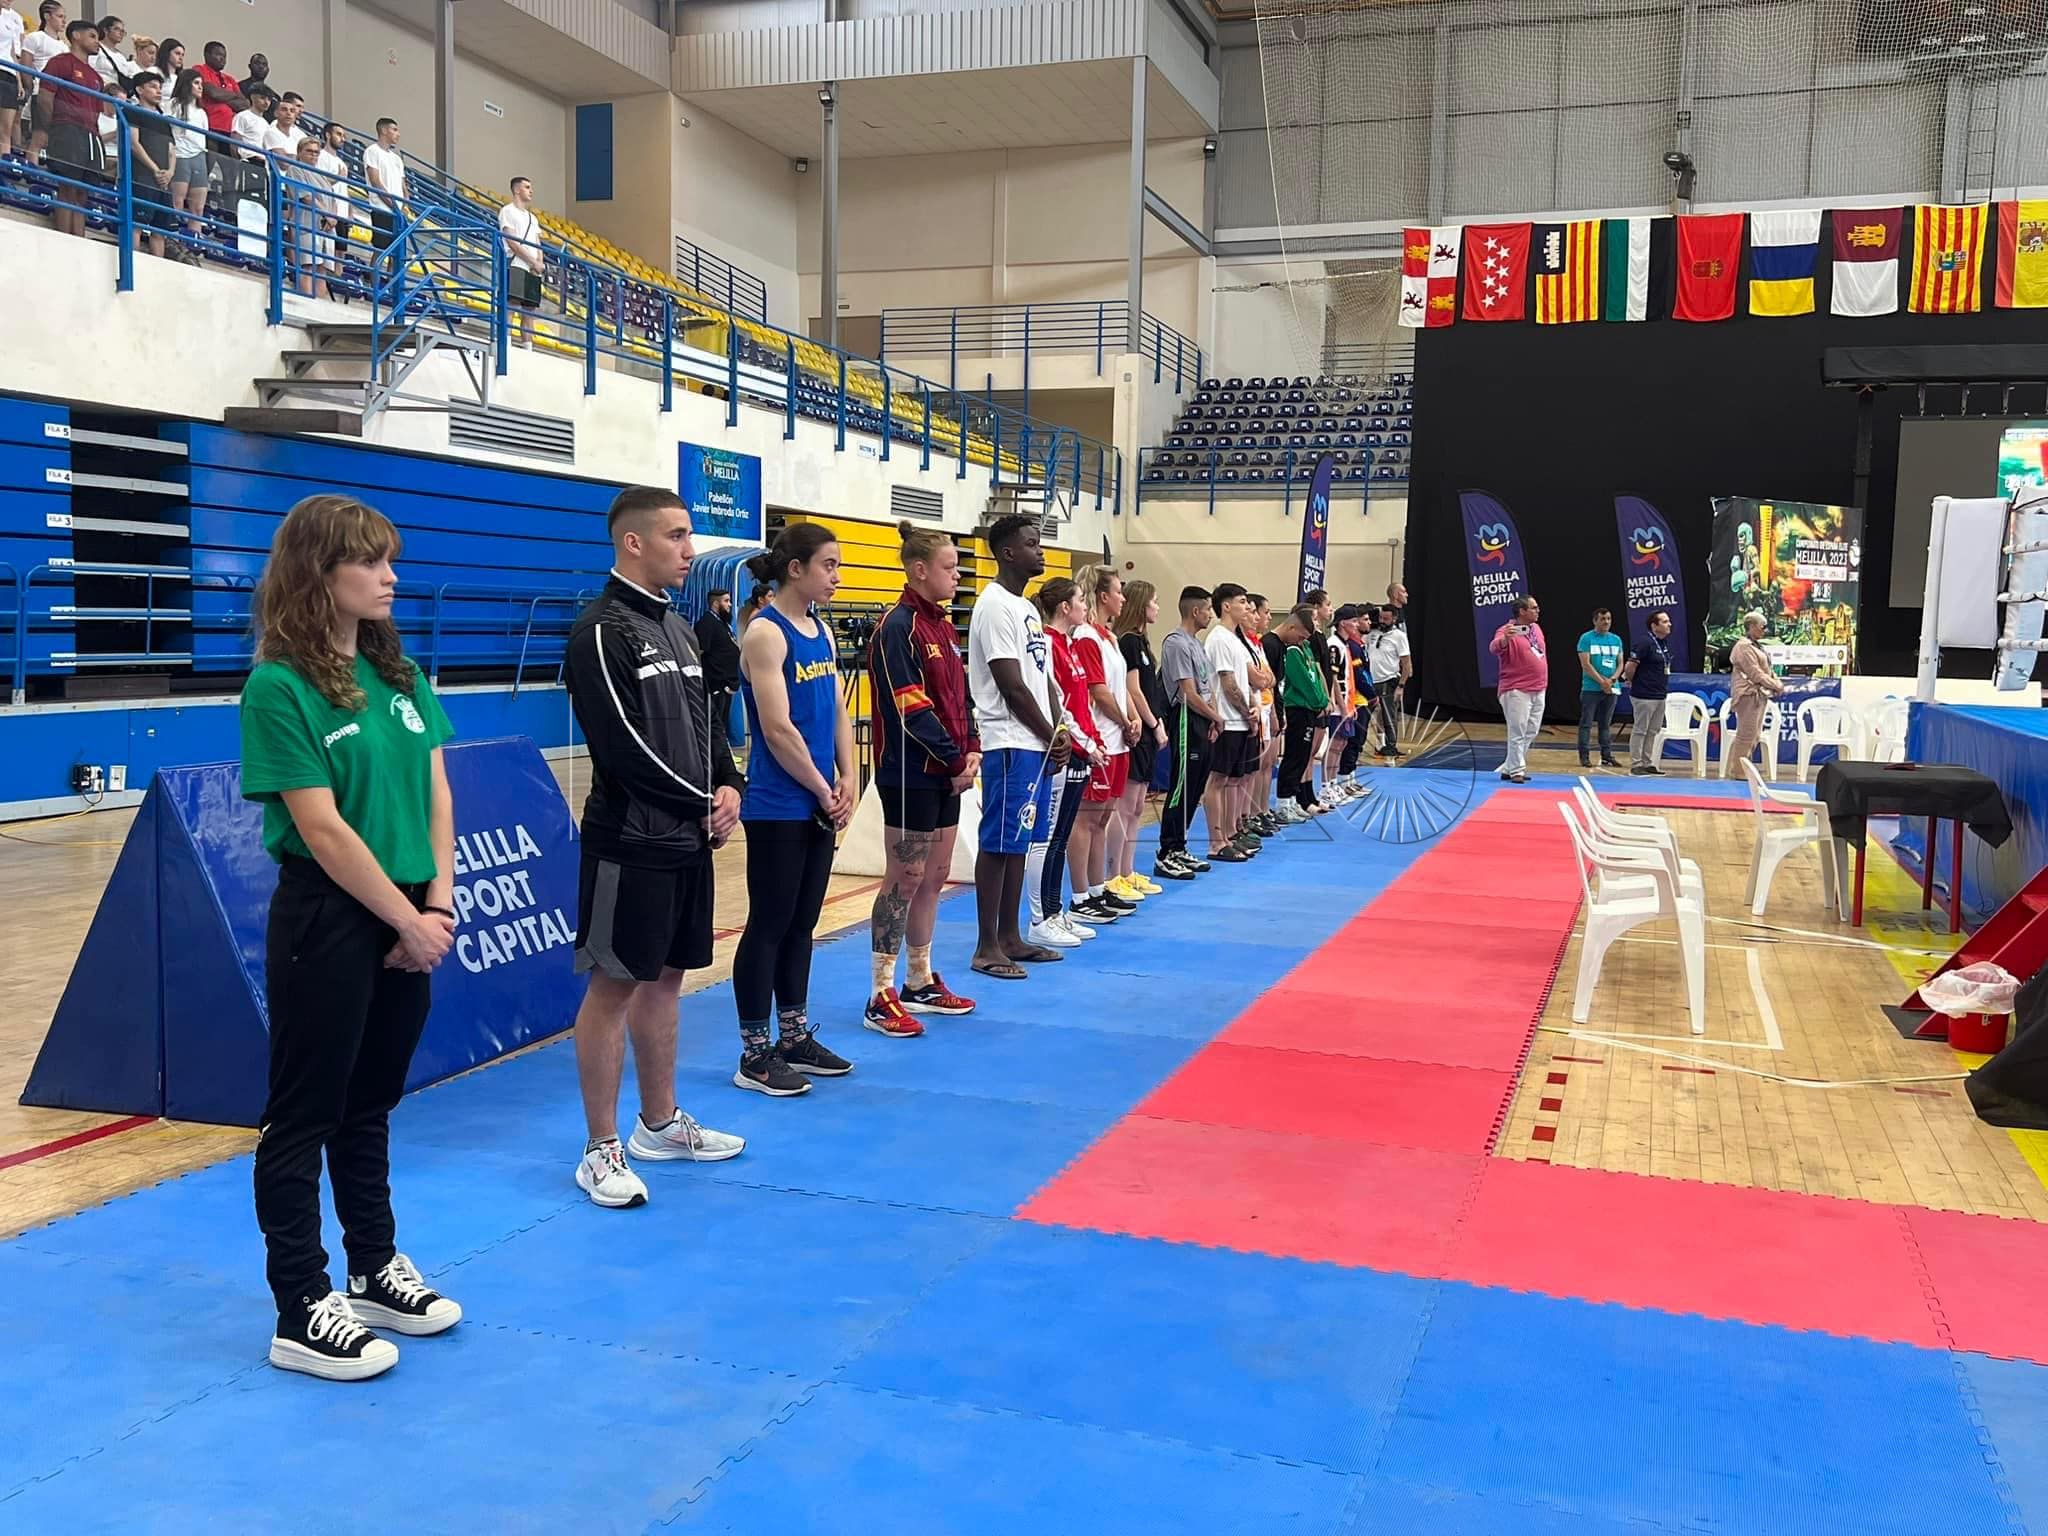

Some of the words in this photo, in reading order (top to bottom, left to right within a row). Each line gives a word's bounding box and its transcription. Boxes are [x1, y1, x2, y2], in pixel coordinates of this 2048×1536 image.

[63, 427, 69, 437] 5
[64, 472, 71, 482] 4
[713, 465, 740, 480] MELILLA
[65, 517, 71, 526] 3
[1795, 549, 1827, 564] MELILLA
[1829, 552, 1848, 565] 2023
[1473, 570, 1520, 586] MELILLA
[1627, 573, 1676, 589] MELILLA
[1473, 582, 1512, 597] SPORT
[1628, 585, 1667, 599] SPORT
[1628, 594, 1678, 609] CAPITAL
[454, 824, 543, 875] ELILLA
[456, 908, 577, 973] CAPITAL
